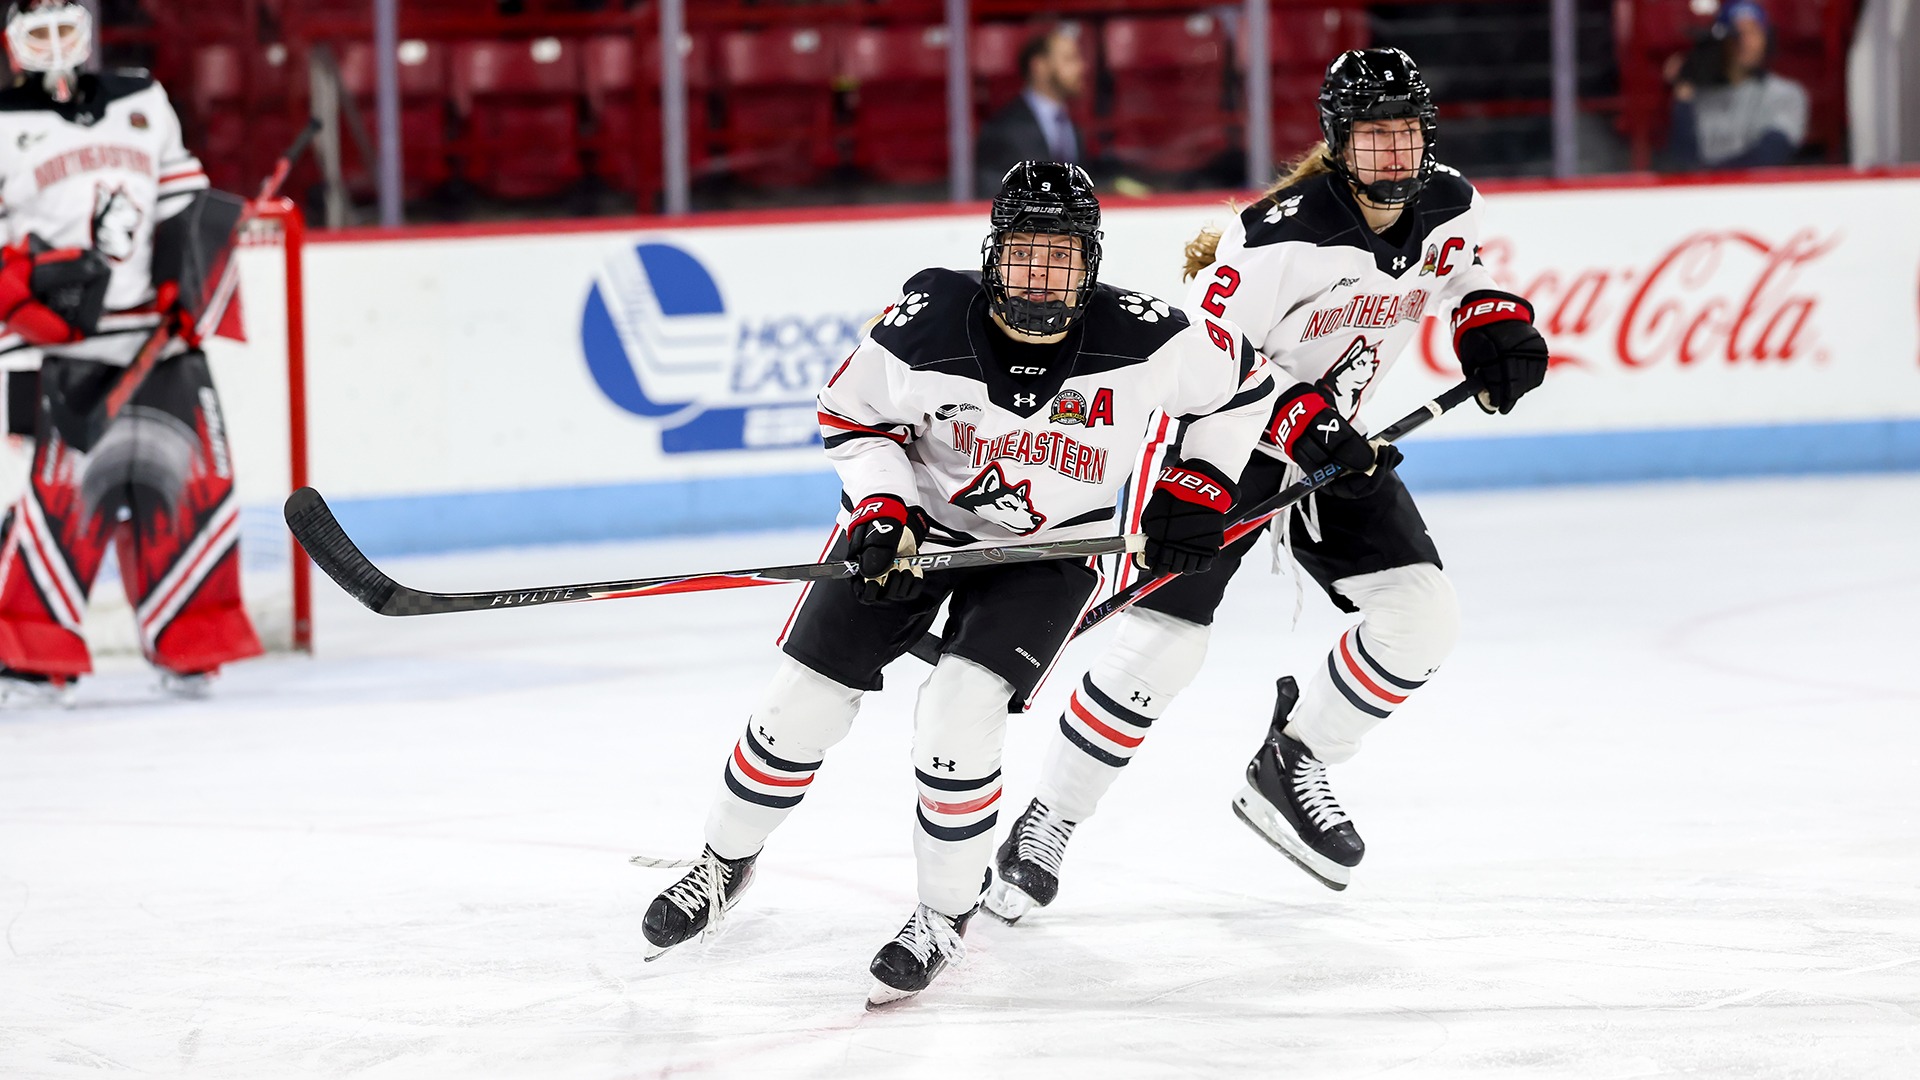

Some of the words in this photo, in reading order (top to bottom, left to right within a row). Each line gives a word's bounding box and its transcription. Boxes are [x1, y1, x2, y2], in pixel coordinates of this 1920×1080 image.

[1383, 70, 1395, 81] 2
[1040, 182, 1052, 192] 9
[1024, 205, 1063, 215] BAUER
[1435, 237, 1466, 278] C
[1200, 264, 1241, 319] 2
[1418, 226, 1843, 378] Cca-Cola
[737, 315, 870, 348] HOCK
[1451, 301, 1518, 336] UER
[1084, 387, 1114, 428] A
[1274, 401, 1308, 453] UER
[950, 419, 1108, 484] NOTHEASTERN
[1160, 466, 1222, 501] UER
[490, 588, 575, 606] FLYLITE
[1079, 601, 1113, 629] LITE
[1014, 646, 1041, 669] BAUER
